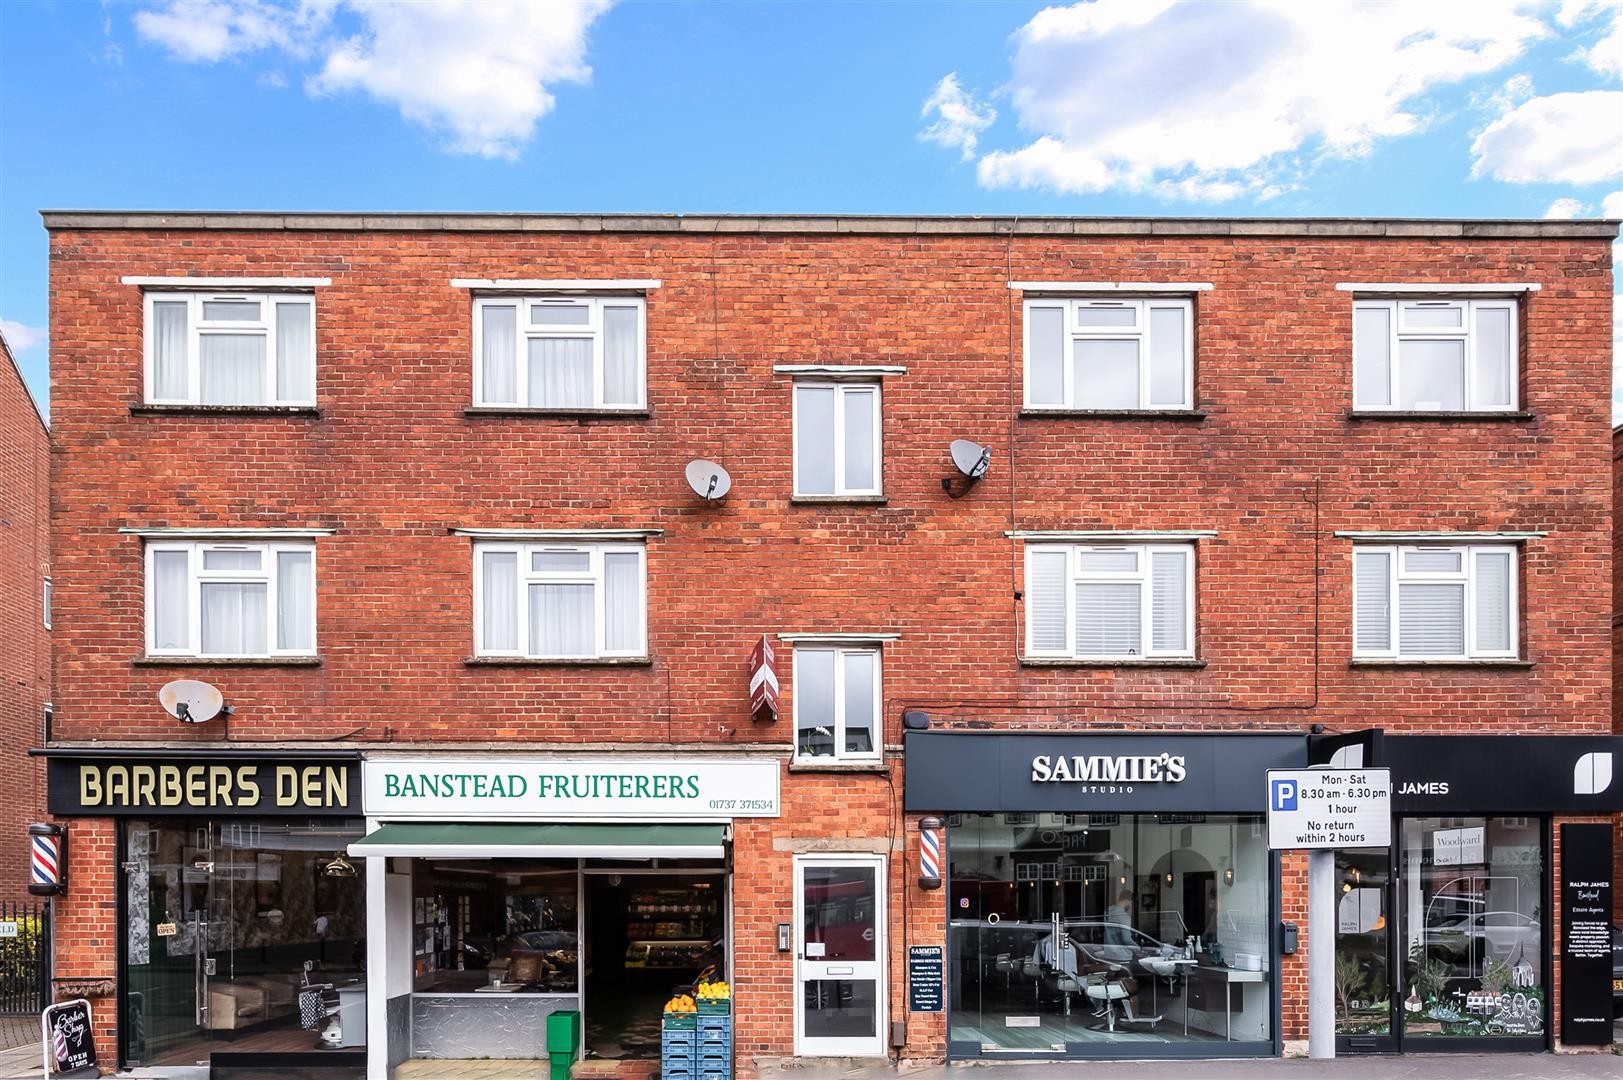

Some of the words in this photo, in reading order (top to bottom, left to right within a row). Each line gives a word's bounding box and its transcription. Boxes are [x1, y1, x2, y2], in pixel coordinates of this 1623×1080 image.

[1321, 775, 1342, 785] Mon
[1350, 775, 1366, 784] Sat
[80, 765, 260, 807] BARBERS
[276, 766, 348, 807] DEN
[385, 774, 527, 798] BANSTEAD
[539, 775, 699, 799] FRUITERERS
[1082, 786, 1133, 794] STUDIO
[1398, 782, 1449, 795] JAMES
[1278, 783, 1294, 809] P
[1301, 789, 1324, 799] 8.30
[1326, 790, 1340, 798] am
[1348, 788, 1370, 798] 6.30
[1372, 789, 1387, 799] pm
[709, 800, 736, 810] 01737
[739, 800, 773, 810] 371534
[1328, 804, 1332, 814] 1
[1335, 804, 1357, 814] hour
[1307, 821, 1321, 831] No
[1324, 820, 1355, 830] return
[1296, 833, 1326, 843] within
[1329, 833, 1336, 843] 2
[1338, 832, 1365, 842] hours
[1437, 834, 1480, 846] Woodward
[57, 1011, 86, 1029] Barber
[68, 1052, 87, 1063] OPEN
